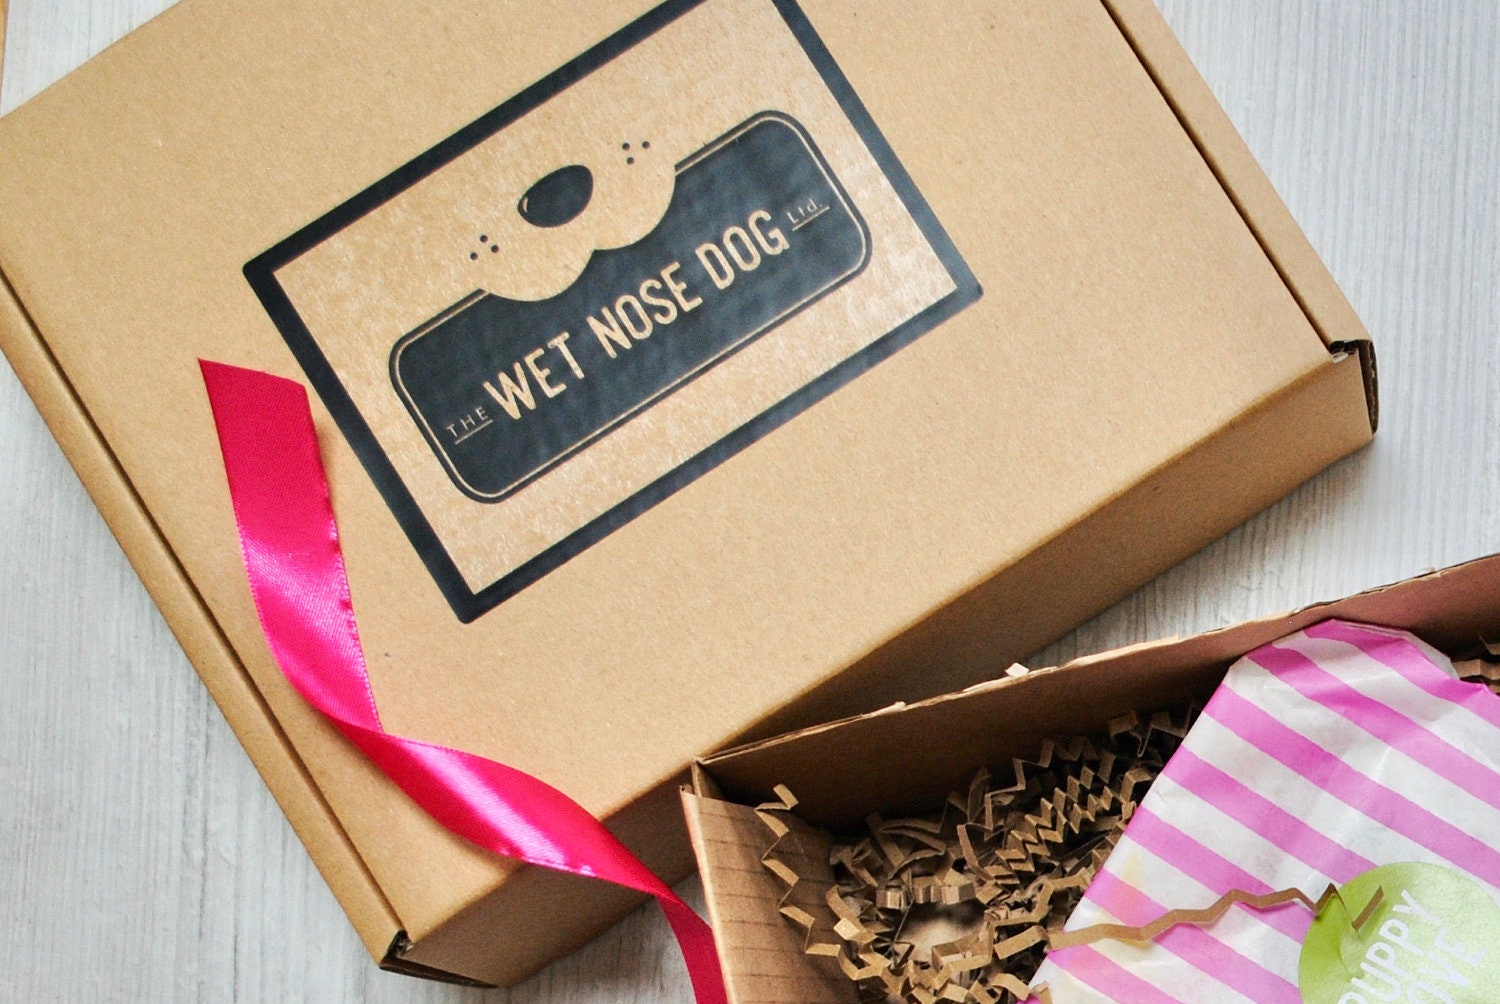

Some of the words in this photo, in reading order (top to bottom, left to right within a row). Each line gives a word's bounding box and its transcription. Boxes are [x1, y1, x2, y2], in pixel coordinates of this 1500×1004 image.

[446, 406, 488, 438] THE
[483, 331, 586, 420] WET
[586, 262, 704, 360] NOSE
[695, 209, 791, 291] DOG
[786, 199, 826, 225] Ltd.
